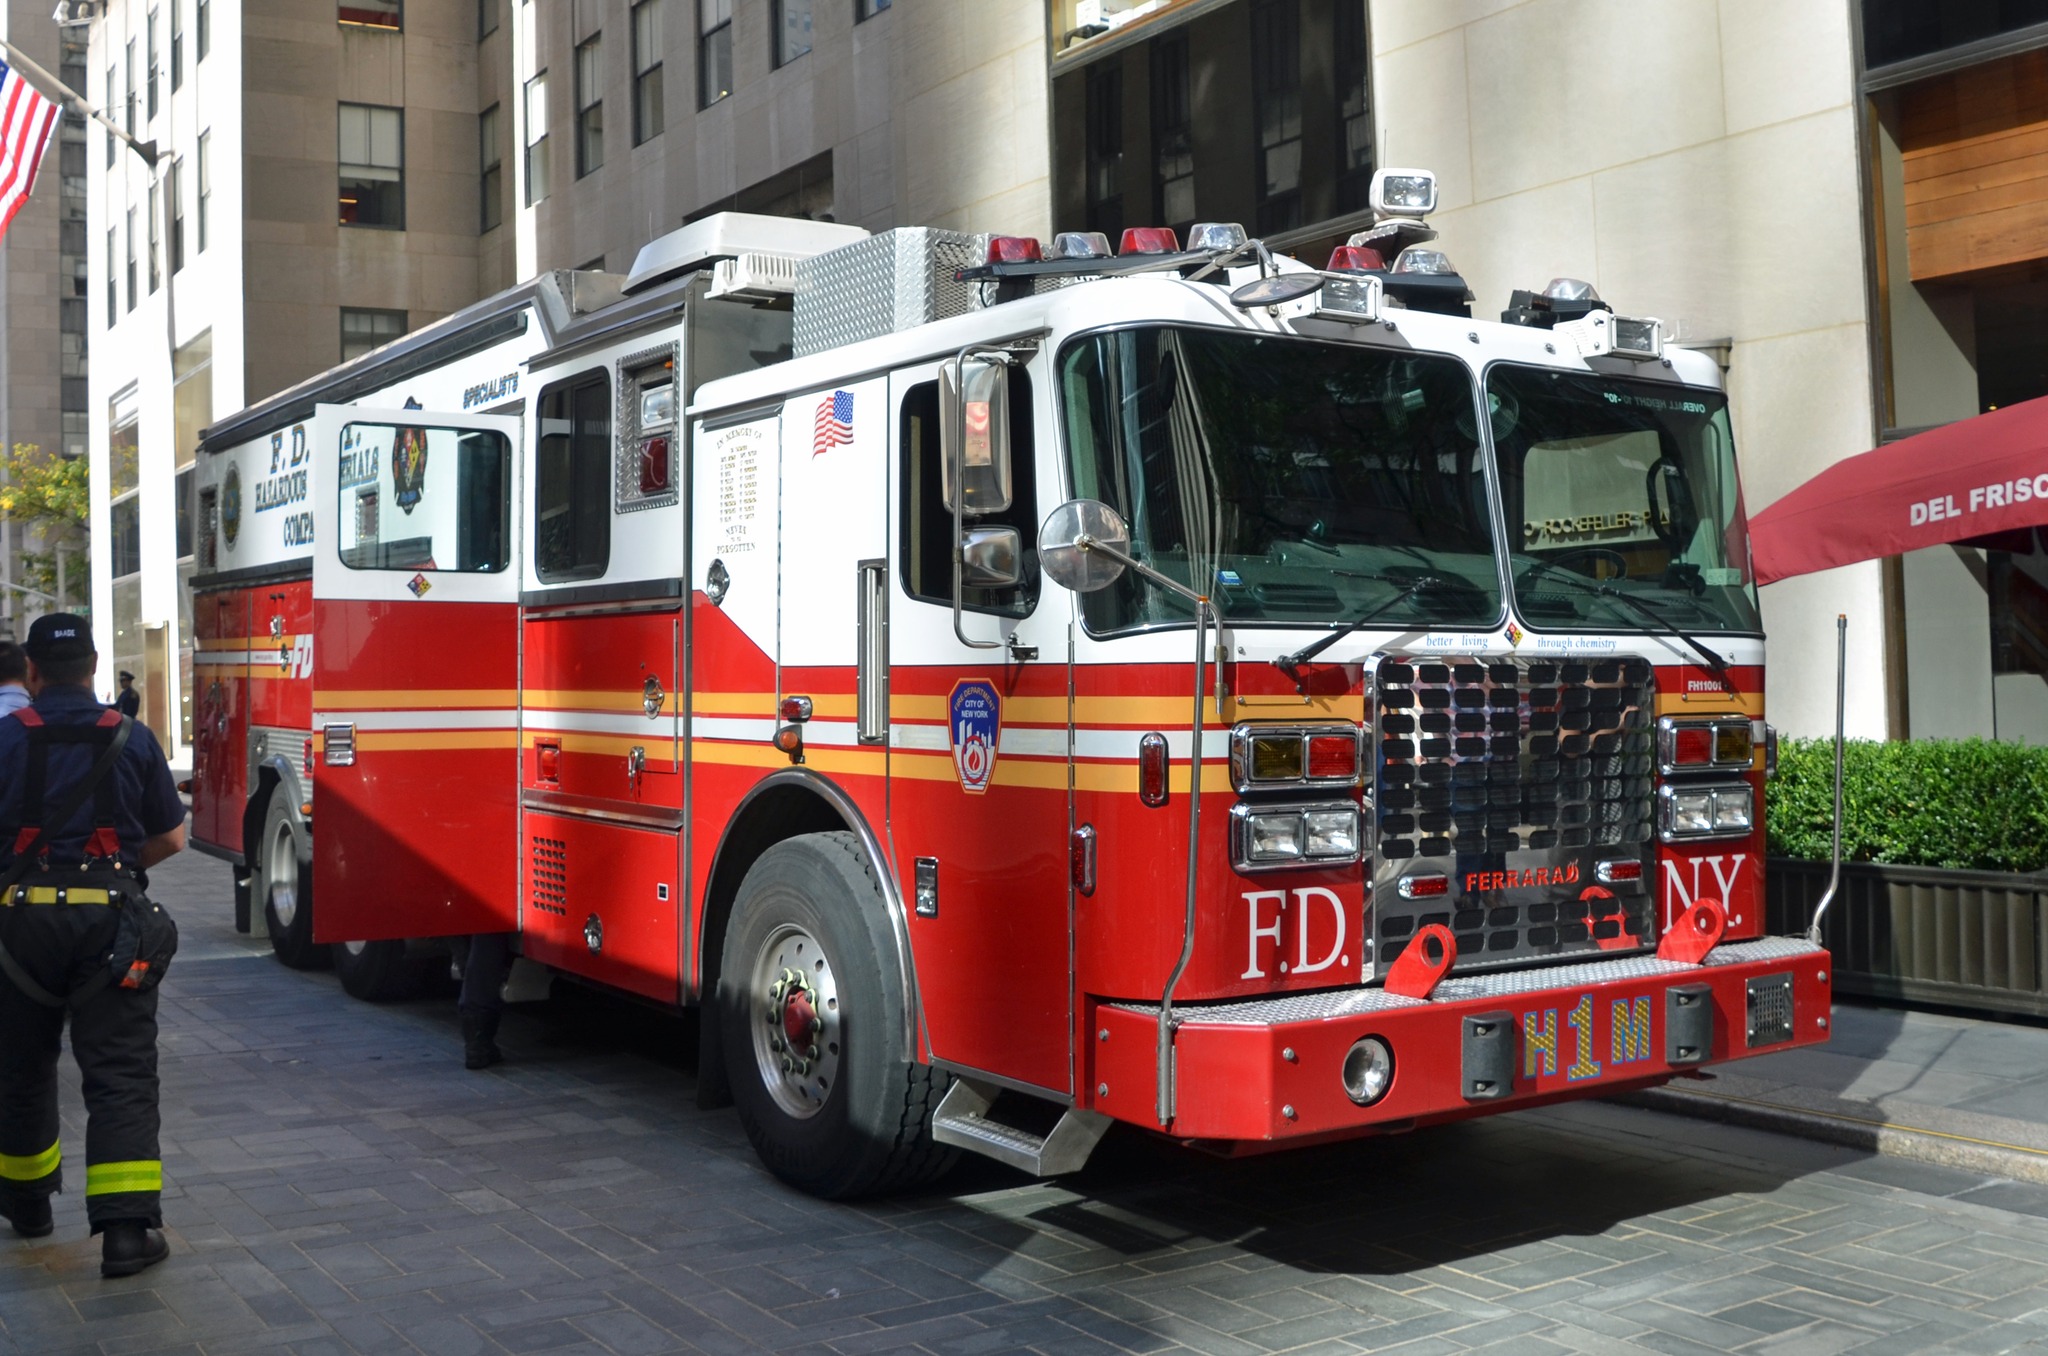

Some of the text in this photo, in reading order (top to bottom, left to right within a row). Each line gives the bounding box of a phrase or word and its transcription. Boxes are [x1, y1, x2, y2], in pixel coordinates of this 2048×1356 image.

[463, 371, 519, 409] SPECIALISTS
[255, 469, 307, 513] HAZARDOUS
[1544, 511, 1632, 534] ROCKEFELLER
[1910, 495, 1962, 527] DEL
[1426, 635, 1617, 653] better living through chemistry
[954, 686, 995, 711] FIRE DEPARTMENT
[962, 710, 973, 718] NEW
[1465, 865, 1563, 892] FERRARA
[1241, 886, 1349, 980] F.D.
